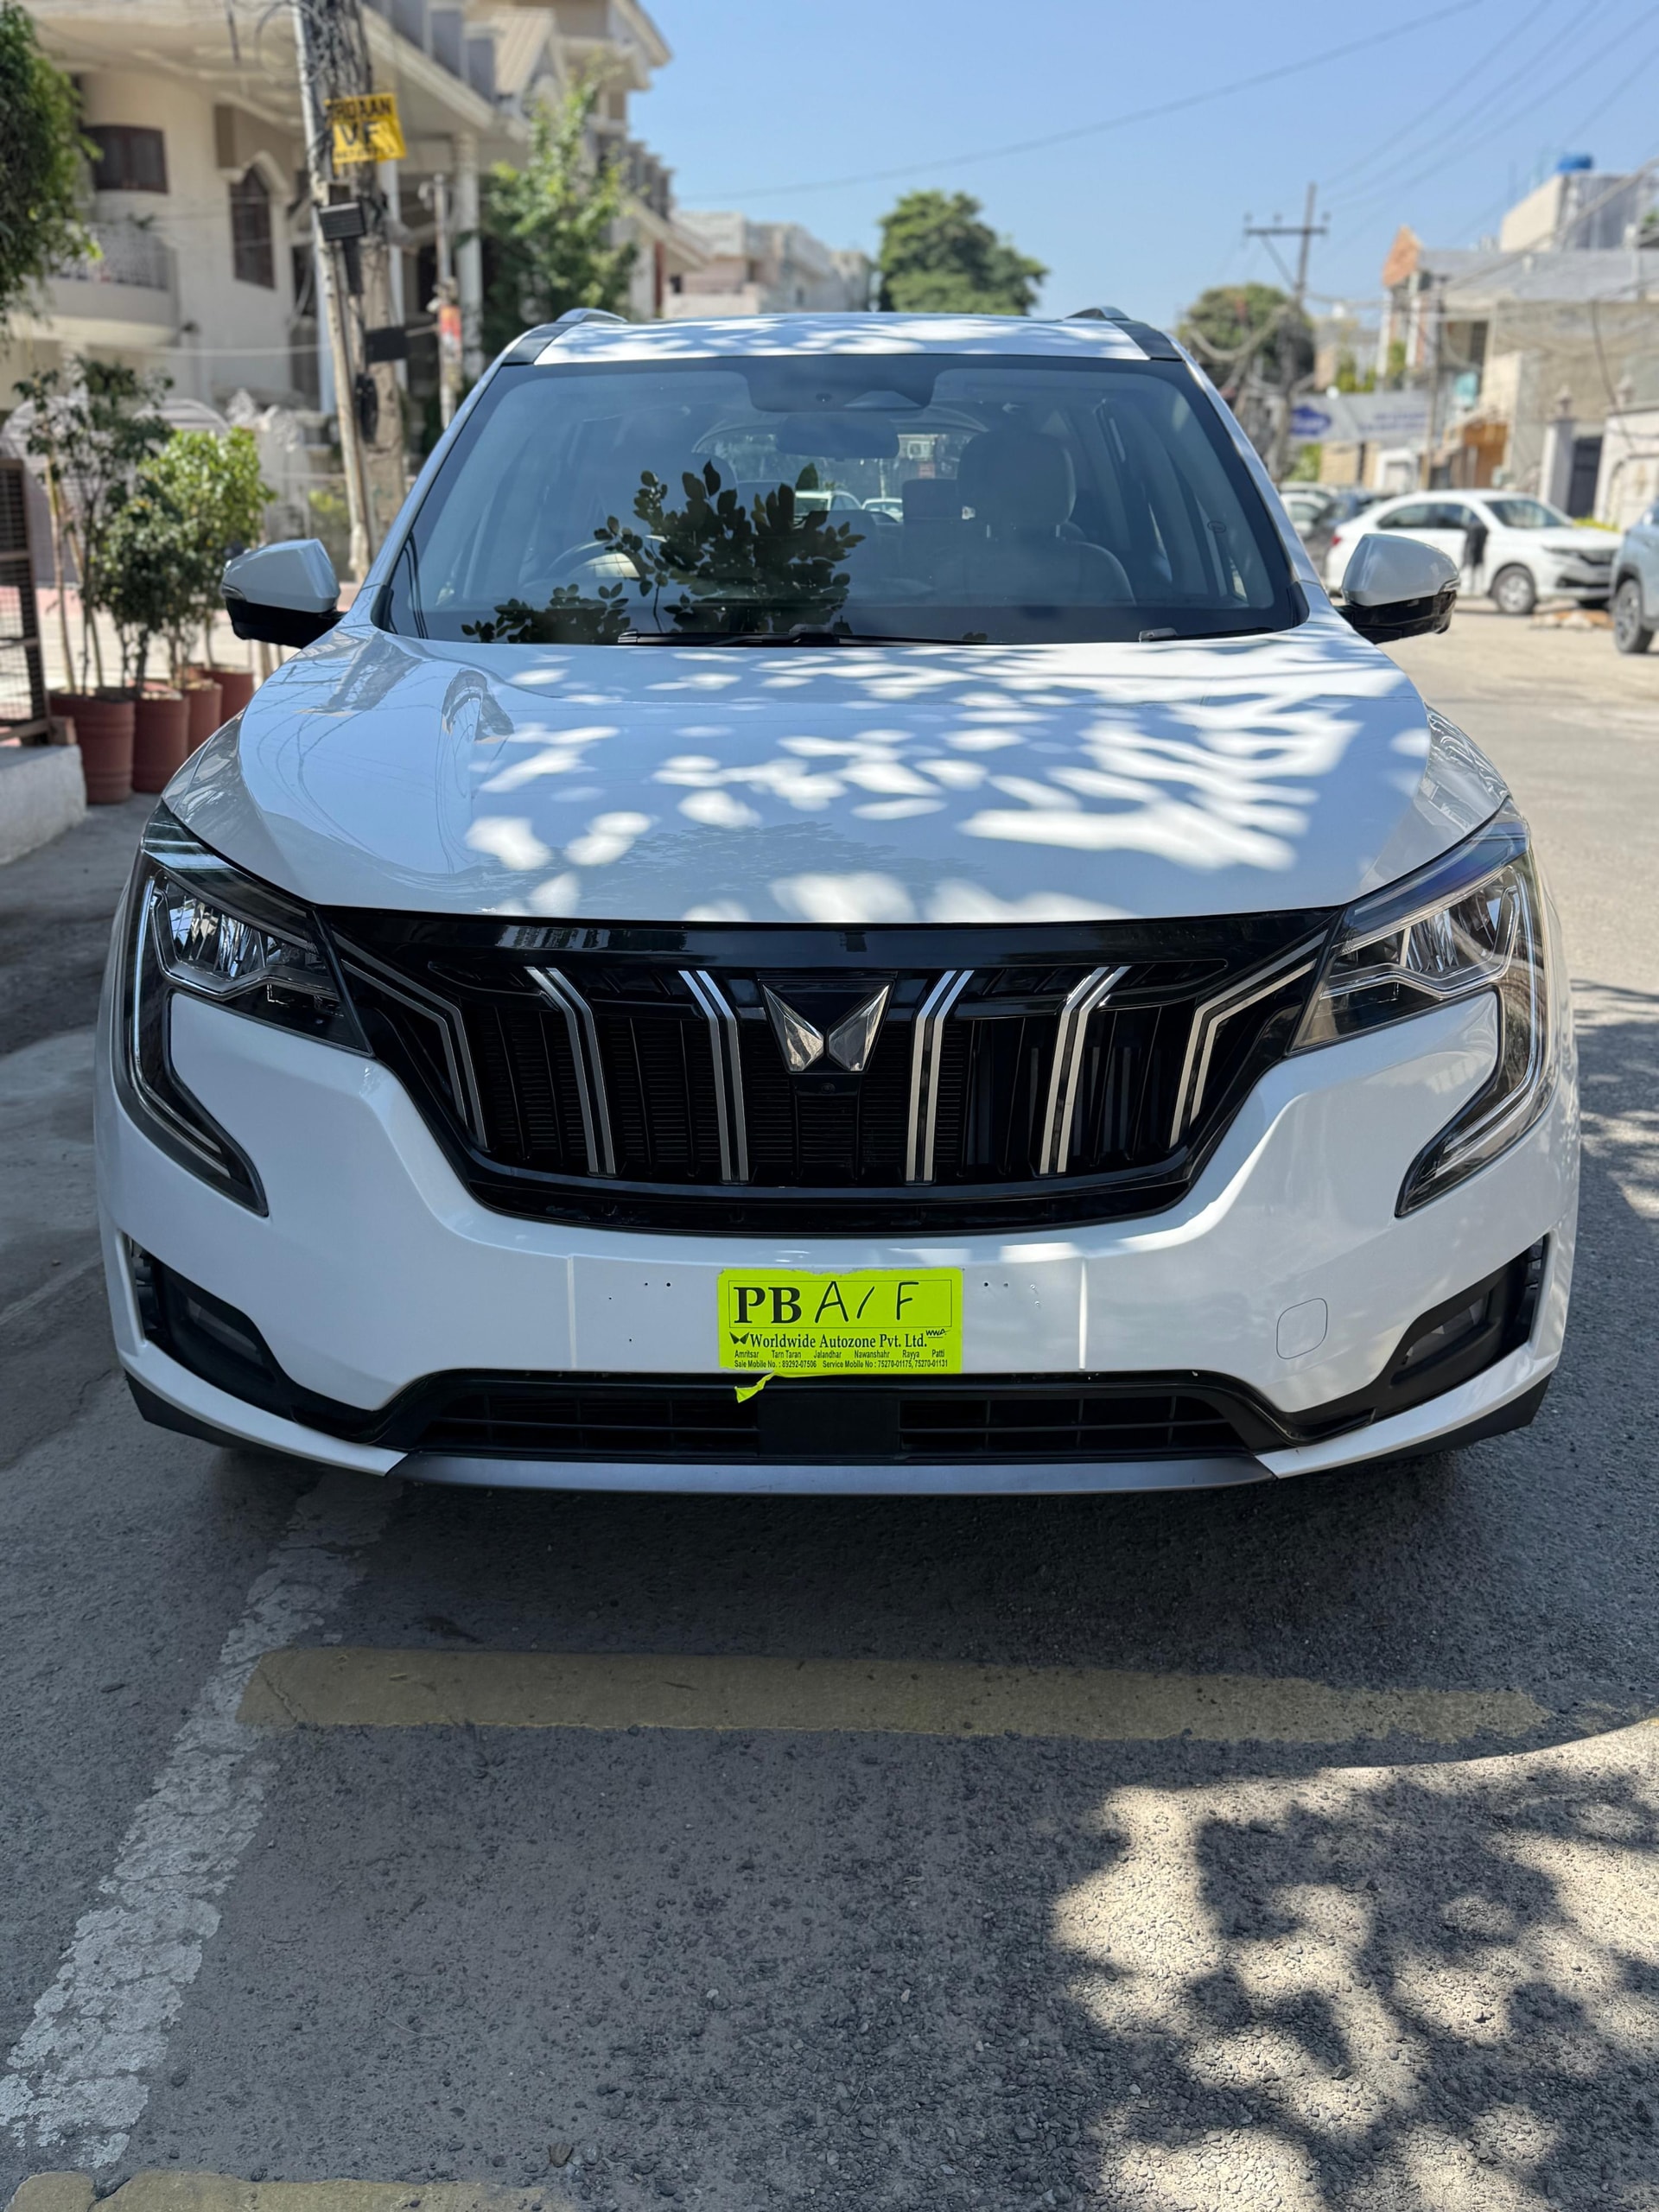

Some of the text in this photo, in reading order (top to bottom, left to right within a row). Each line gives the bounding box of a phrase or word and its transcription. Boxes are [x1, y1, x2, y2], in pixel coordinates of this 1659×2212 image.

[734, 1287, 802, 1324] PB
[750, 1333, 927, 1348] Worldwide Autozone Pvt. Ltd.
[772, 1350, 784, 1358] Tarn
[785, 1350, 801, 1358] Taran
[855, 1350, 890, 1358] Nawanshahr
[902, 1350, 920, 1359] Rayya
